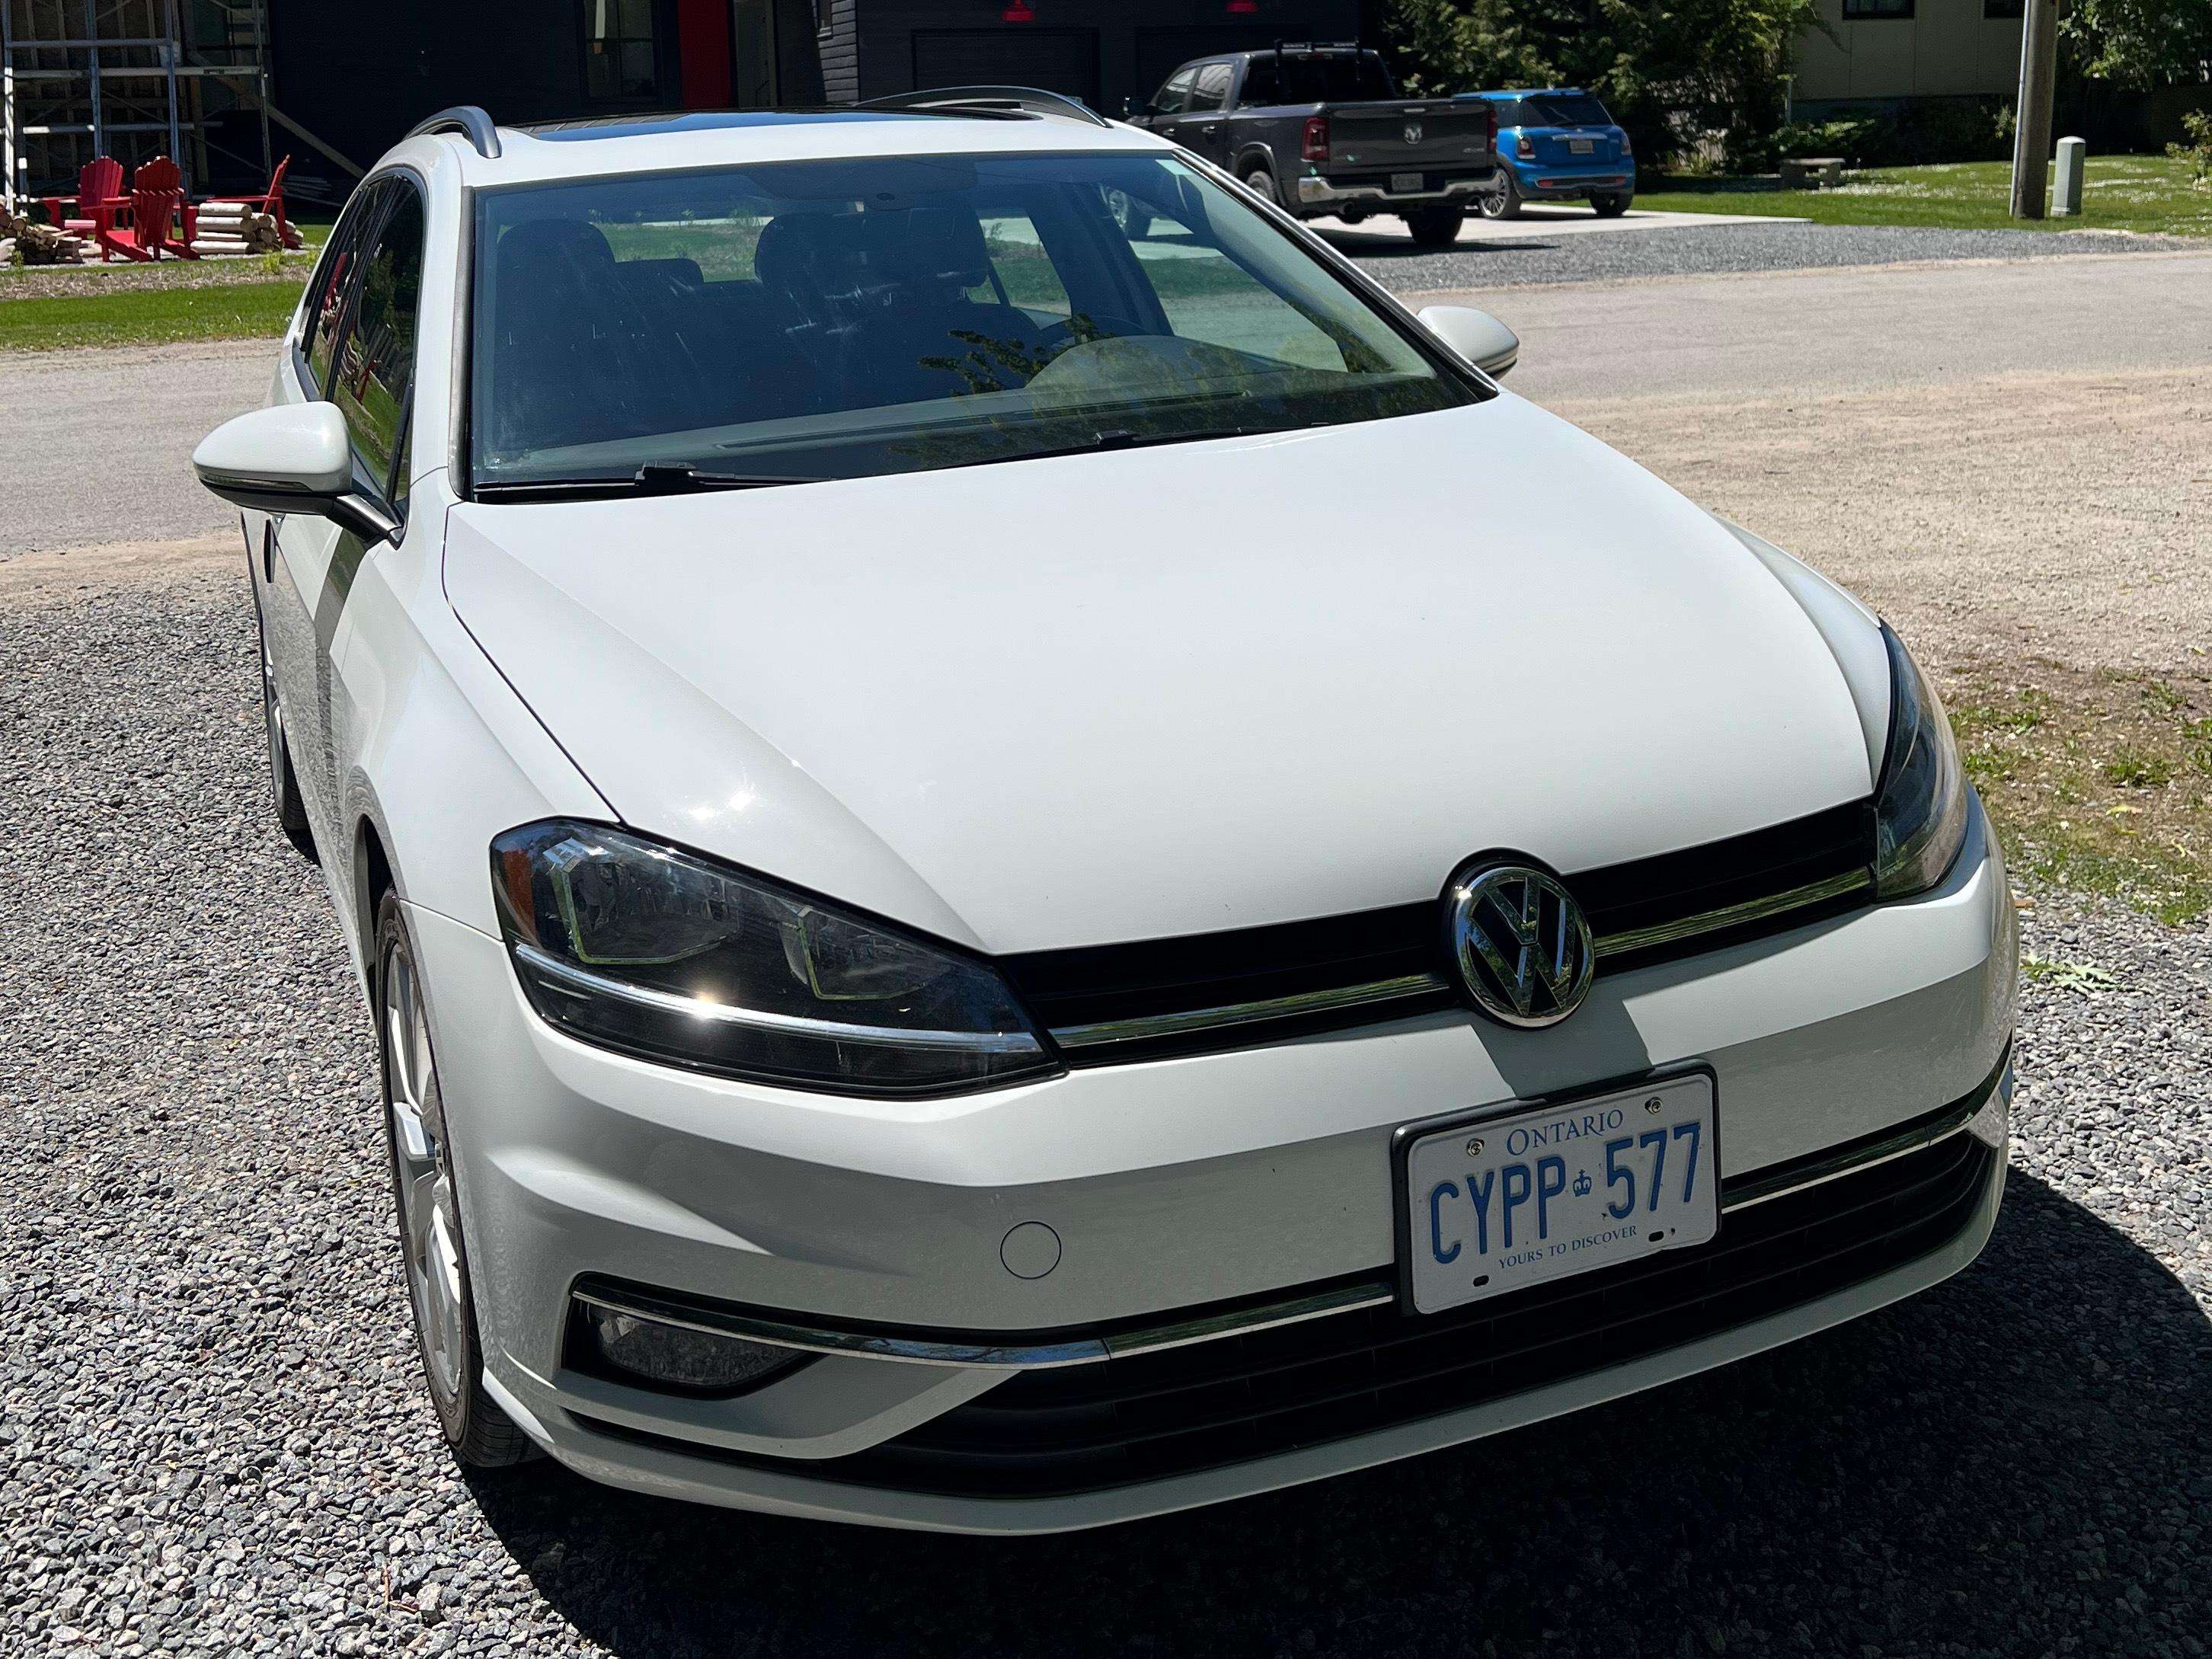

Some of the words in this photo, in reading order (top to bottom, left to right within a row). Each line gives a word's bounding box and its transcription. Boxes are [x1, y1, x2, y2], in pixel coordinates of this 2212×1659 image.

[1507, 1109, 1624, 1156] ONTARIO
[1430, 1156, 1566, 1264] CYPP
[1606, 1122, 1700, 1219] 577
[1498, 1251, 1542, 1269] YOURS
[1549, 1243, 1567, 1257] TO
[1571, 1225, 1637, 1251] DISCOVER
